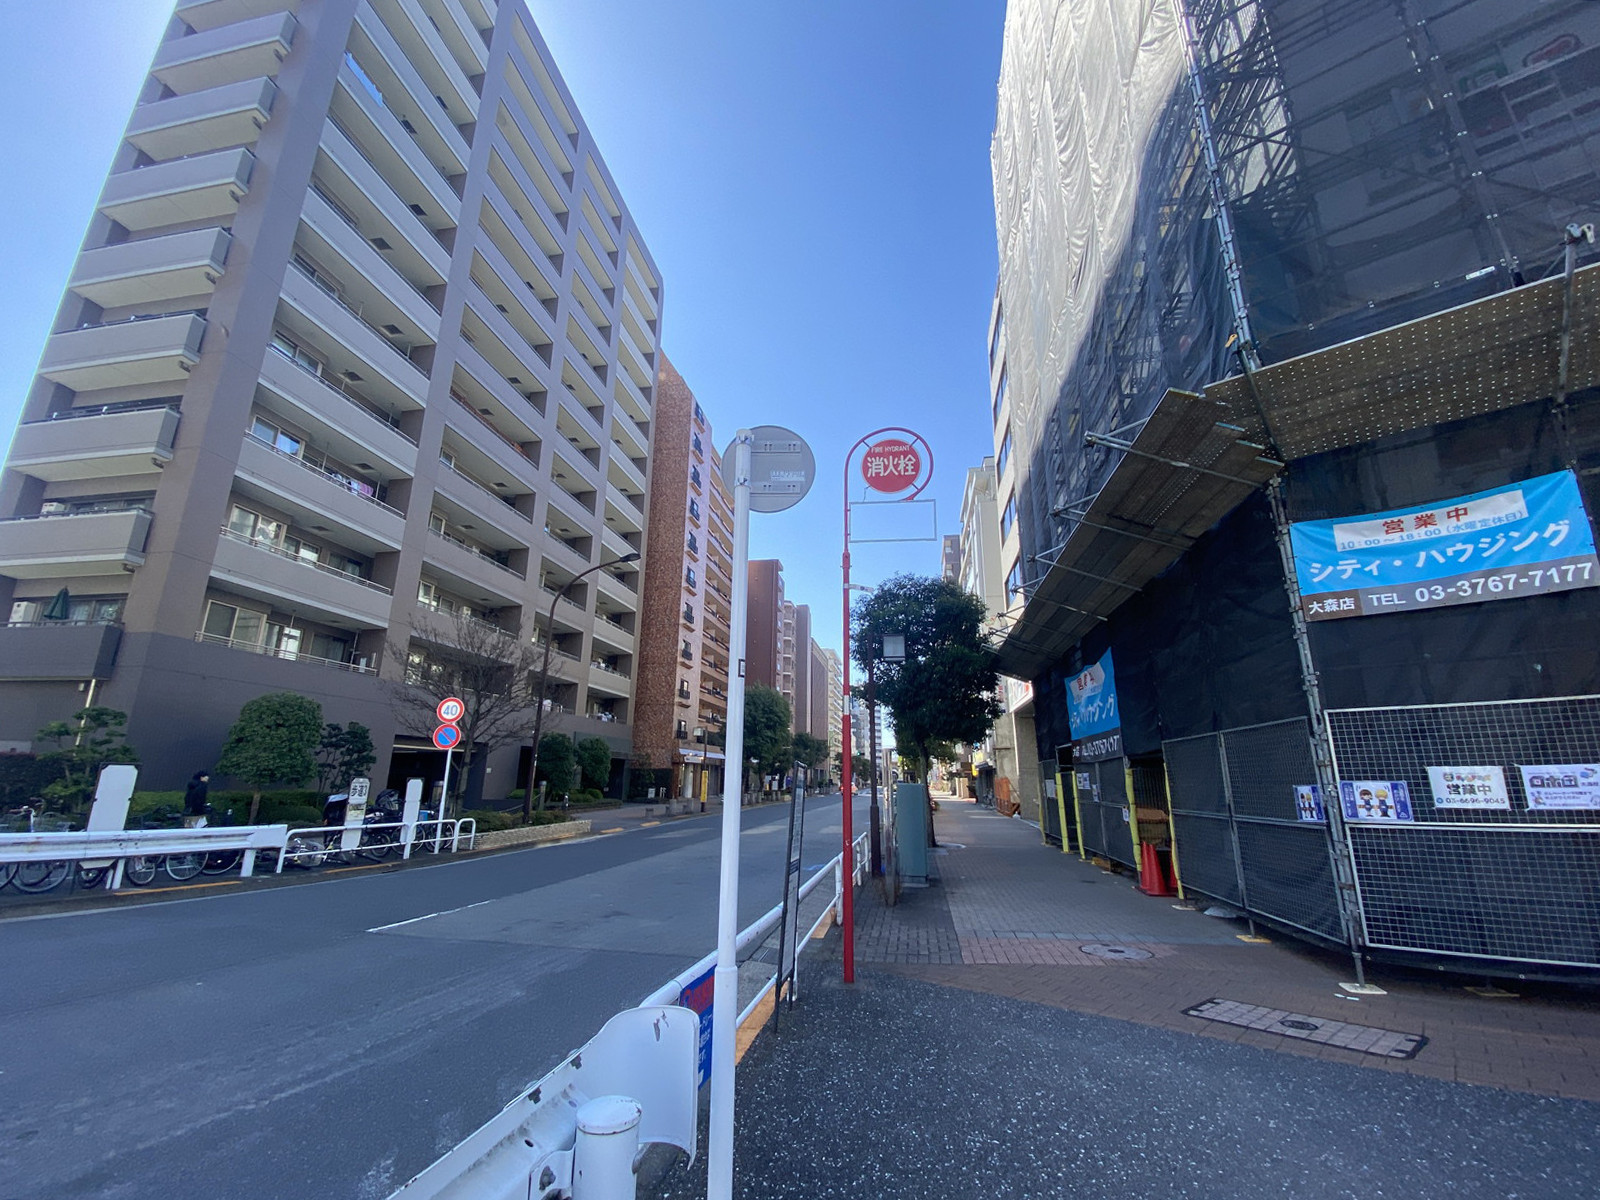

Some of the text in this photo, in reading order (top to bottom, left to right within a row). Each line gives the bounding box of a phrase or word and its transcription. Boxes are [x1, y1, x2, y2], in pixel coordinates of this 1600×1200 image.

[884, 445, 910, 453] HYDRANT
[867, 455, 917, 477] 消火栓
[1382, 506, 1469, 535] 営業中
[1310, 519, 1570, 583] シティ・ハウジング
[1308, 562, 1593, 615] 大森店 TEL 03-3767-7177
[443, 704, 458, 717] 40
